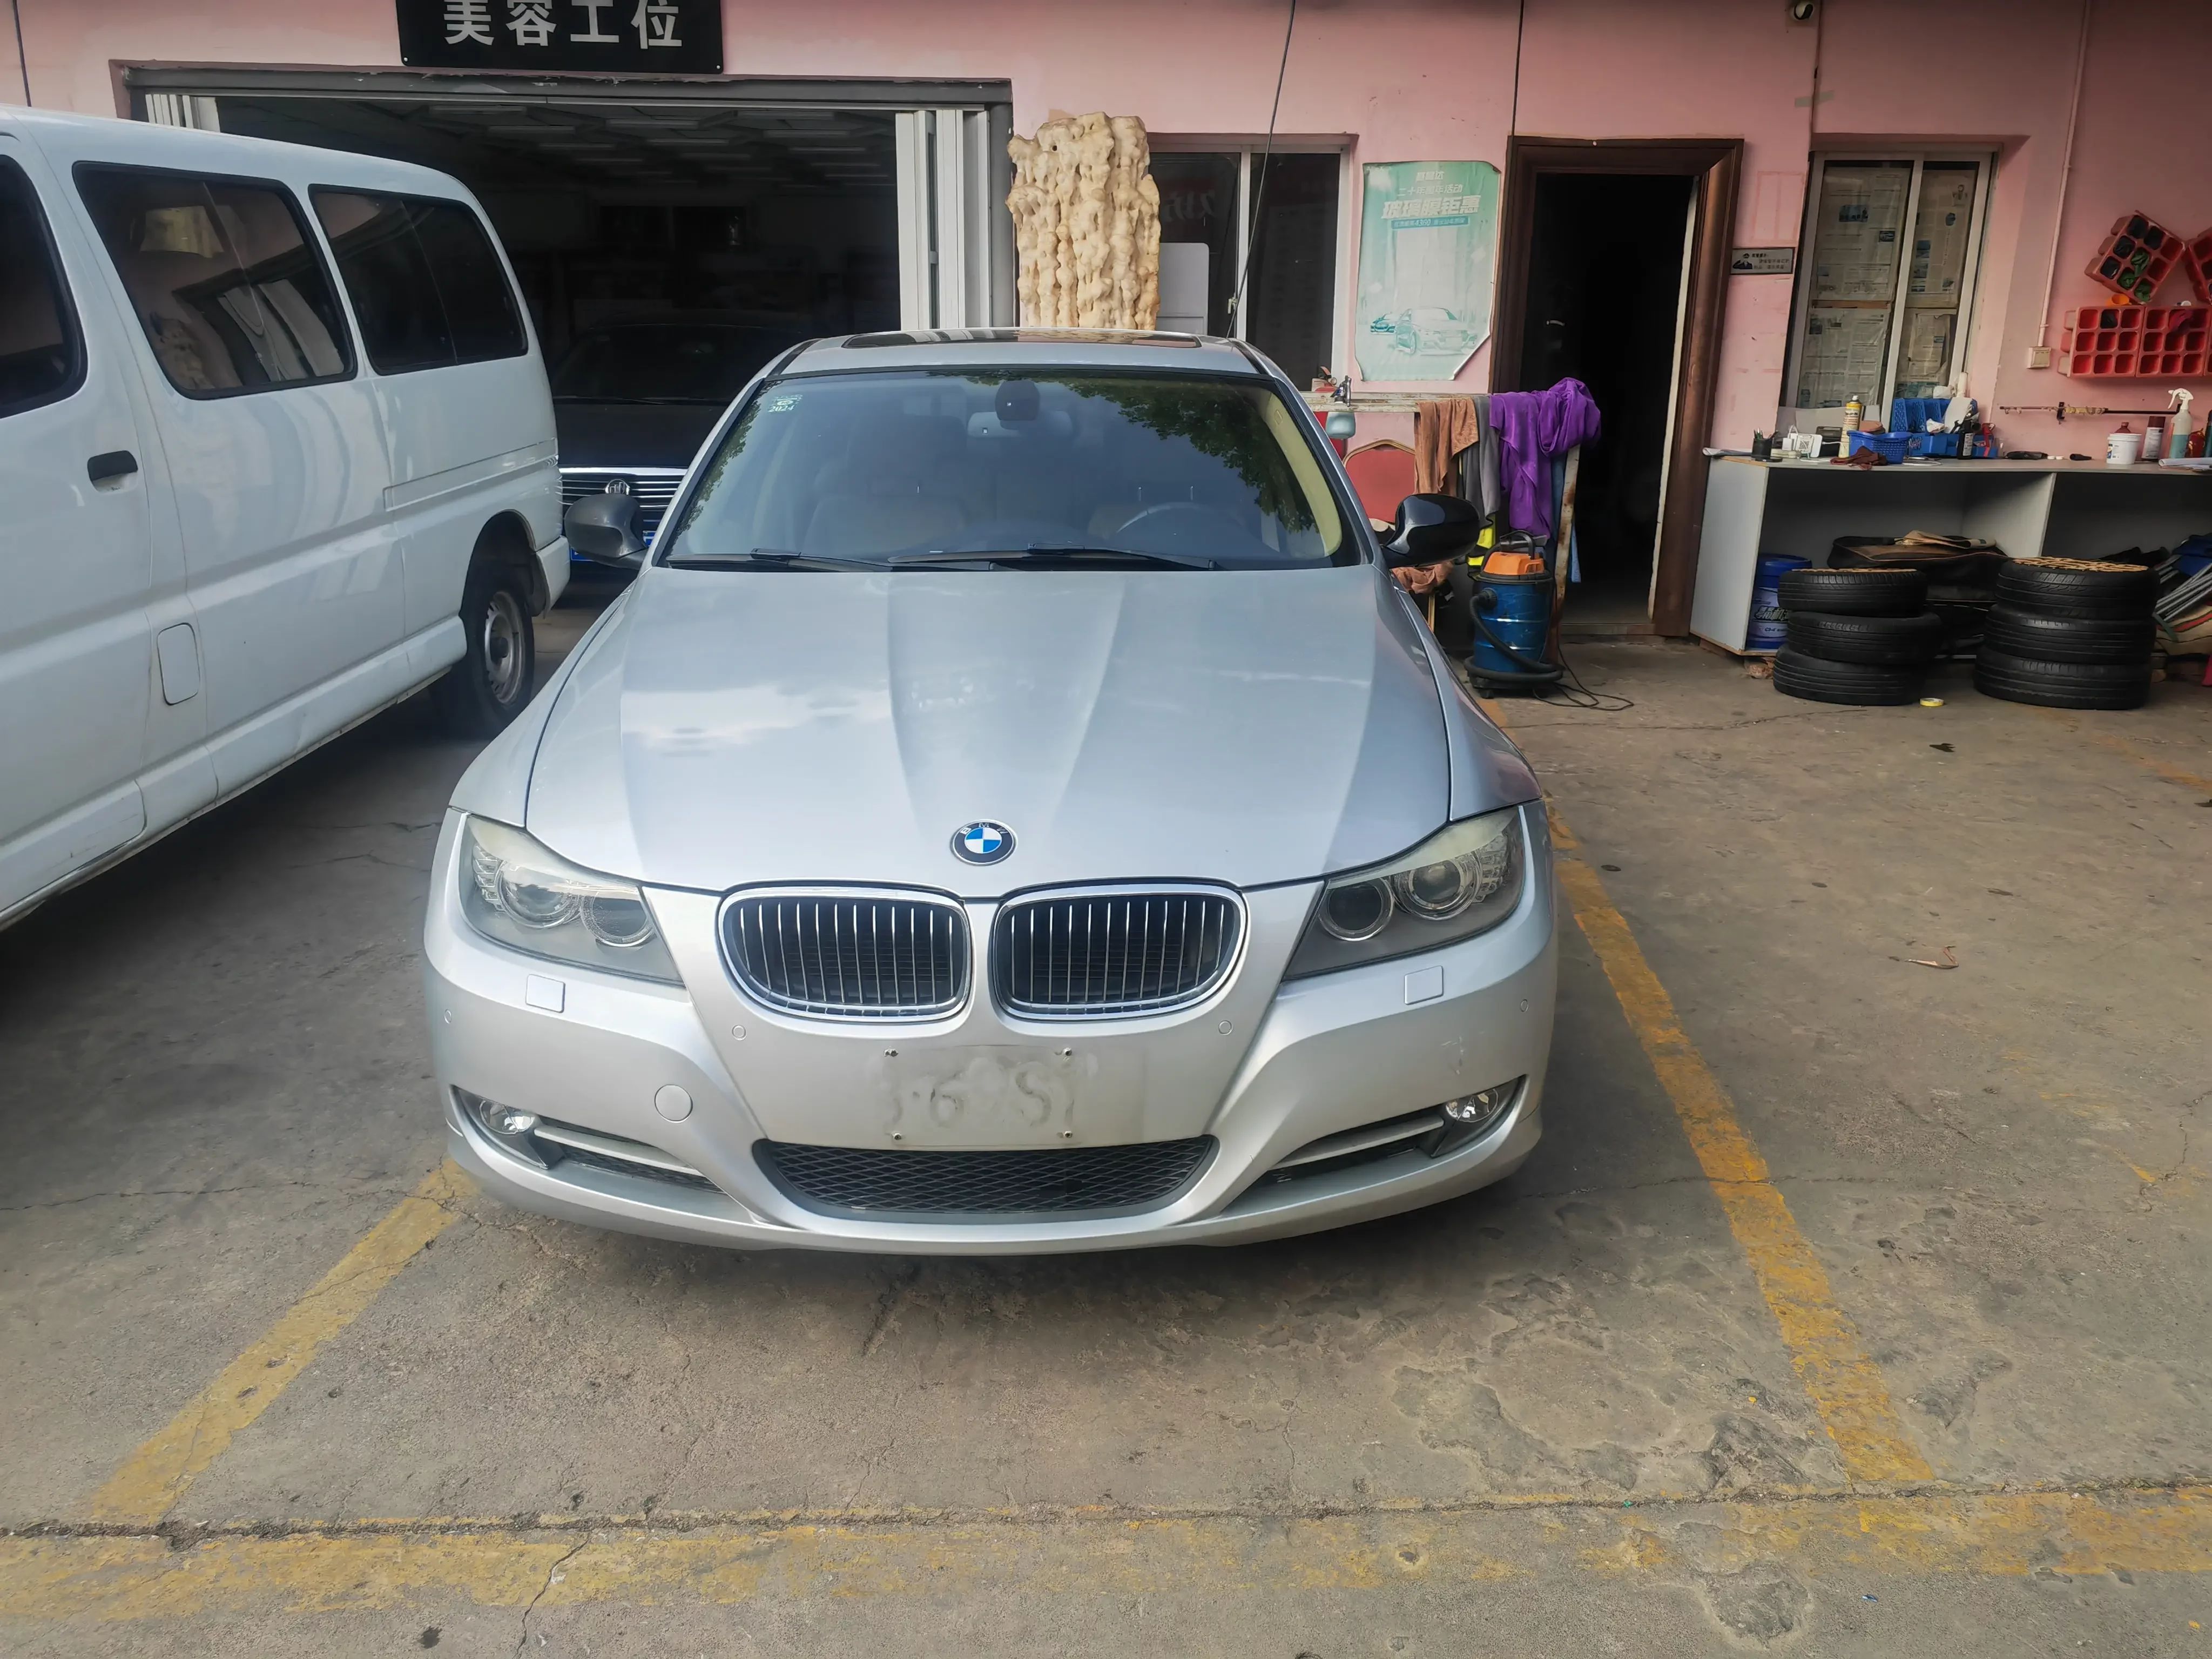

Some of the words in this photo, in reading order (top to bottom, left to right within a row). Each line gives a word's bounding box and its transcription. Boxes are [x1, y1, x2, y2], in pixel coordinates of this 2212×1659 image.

[443, 0, 683, 50] 美容工位
[960, 822, 1008, 834] BMW
